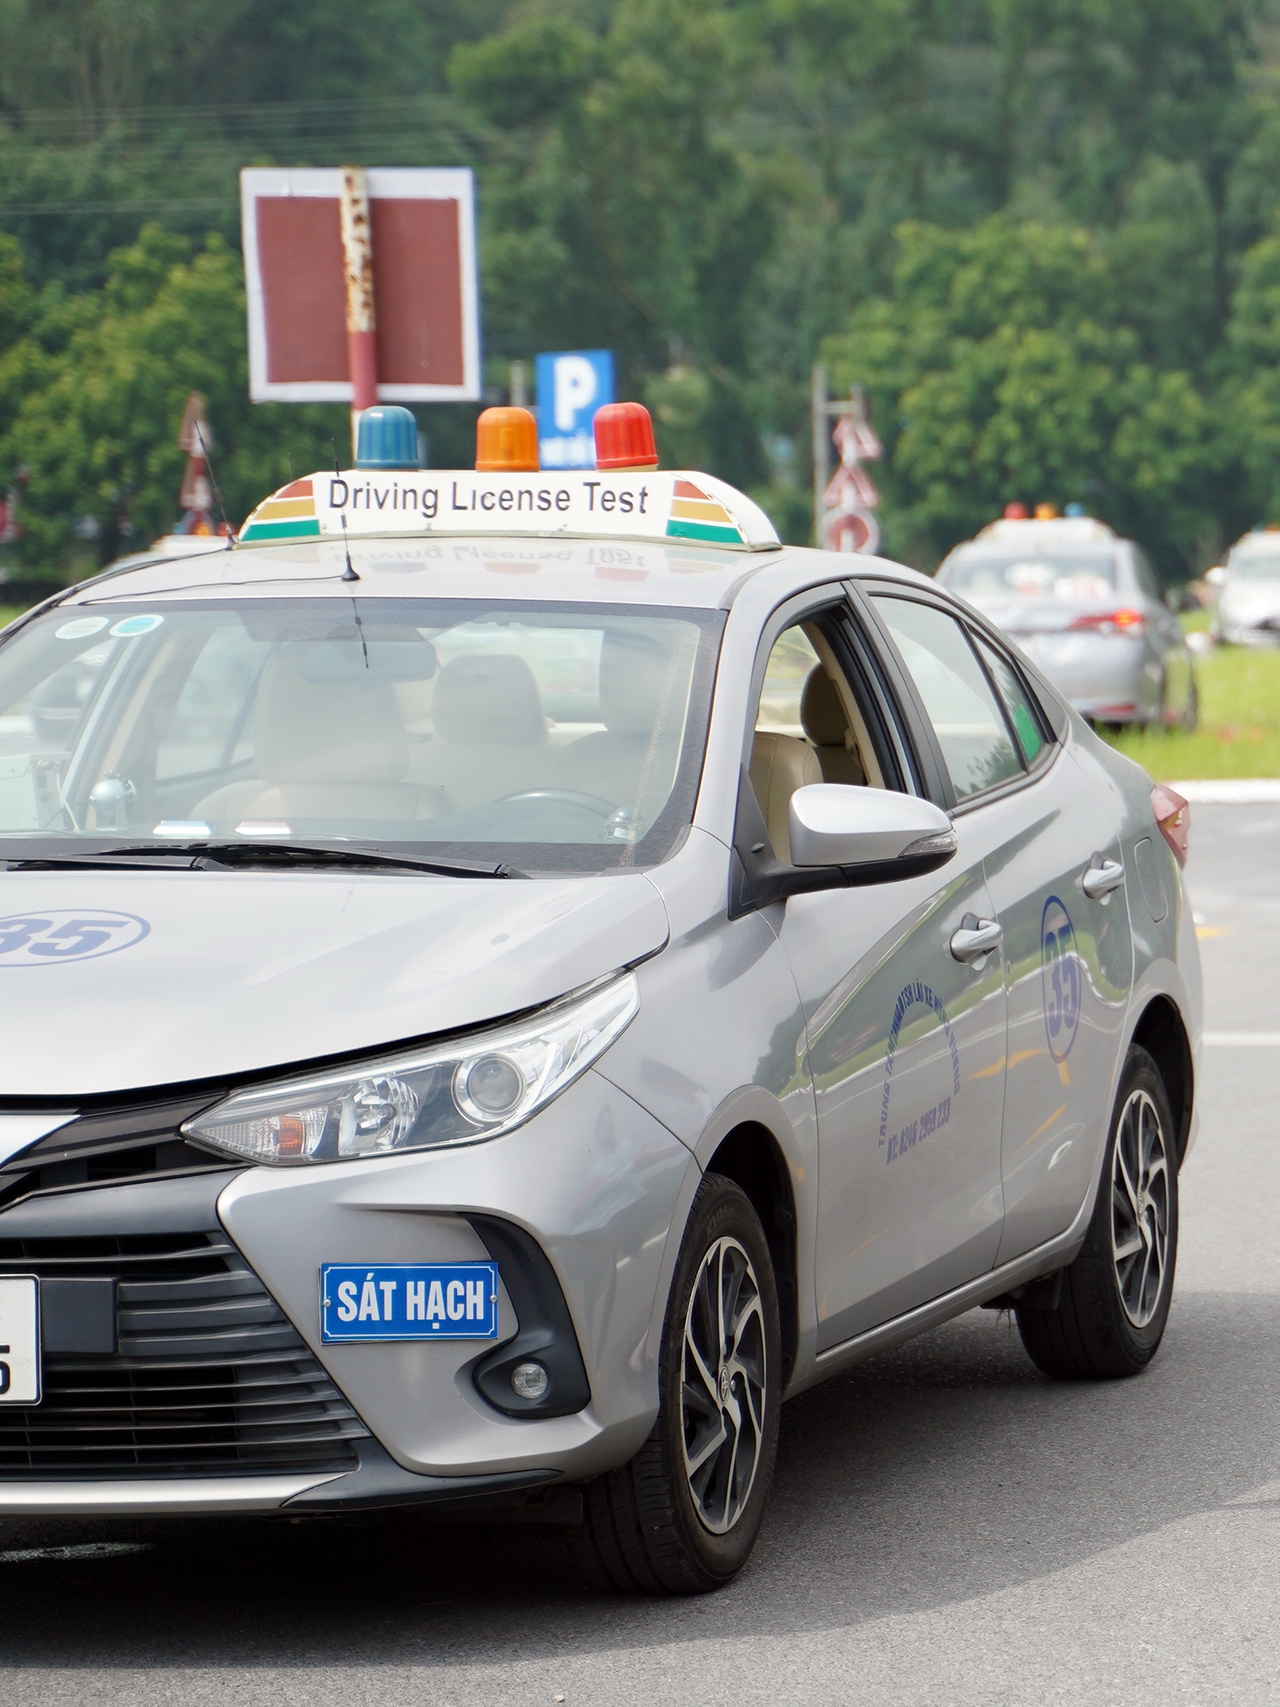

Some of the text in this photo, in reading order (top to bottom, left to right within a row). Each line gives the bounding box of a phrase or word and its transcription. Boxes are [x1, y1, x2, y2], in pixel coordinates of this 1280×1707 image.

[554, 356, 596, 431] P
[328, 479, 648, 518] Driving License Test
[1045, 923, 1076, 1038] 35
[337, 1273, 484, 1329] SÁT HẠCH
